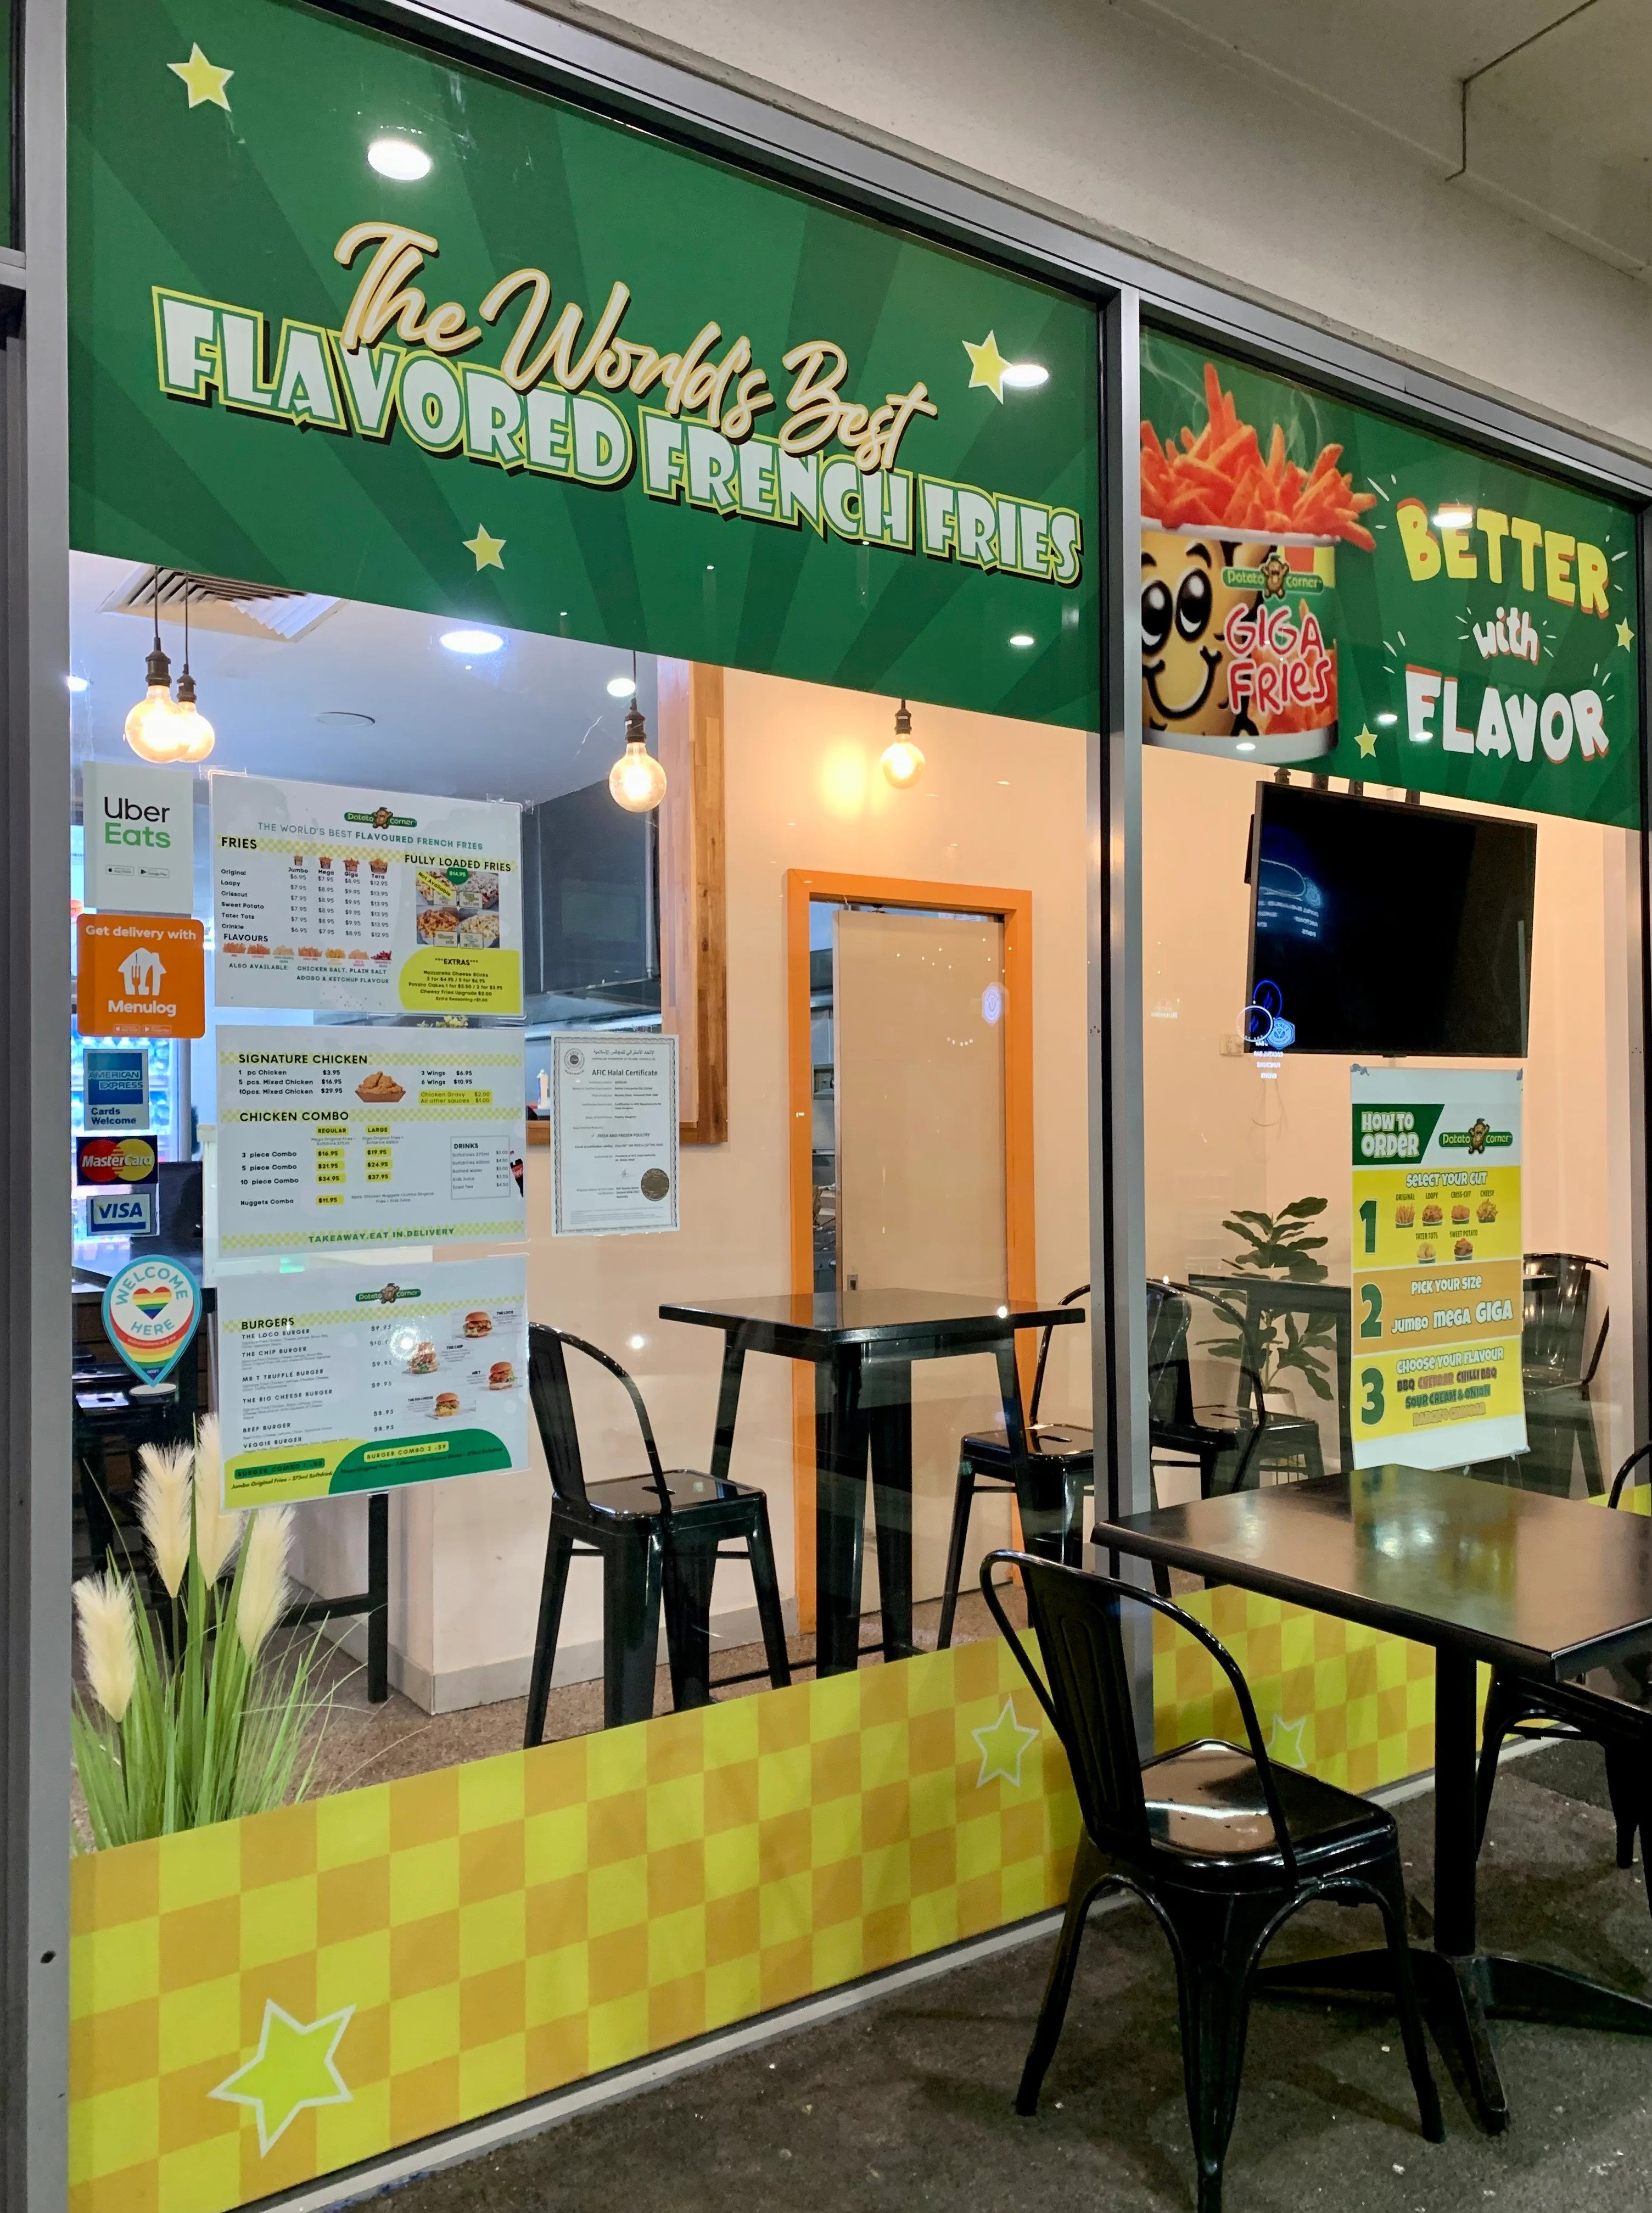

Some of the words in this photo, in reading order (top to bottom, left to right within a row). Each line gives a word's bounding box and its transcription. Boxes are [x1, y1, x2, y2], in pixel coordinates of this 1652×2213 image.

[334, 221, 481, 353] The
[479, 267, 774, 439] World's
[780, 340, 939, 472] Best
[151, 286, 636, 489] FLAVORED
[637, 404, 916, 543] FRENCH
[918, 473, 1083, 584] FRIES
[1396, 497, 1609, 619] BETTER
[1227, 569, 1264, 584] Potato
[1224, 603, 1324, 658] GIGA
[1472, 606, 1539, 665] with
[1405, 664, 1609, 764] FLAVOR
[104, 796, 170, 823] Uber
[347, 813, 374, 822] Potato
[105, 822, 171, 848] Eats
[221, 836, 257, 850] FRIES
[258, 823, 277, 831] THE
[281, 824, 325, 836] WORLD'S
[329, 829, 352, 838] BEST
[356, 832, 413, 843] FLAVOURED
[417, 837, 453, 847] FRENCH
[457, 841, 483, 850] FRIES
[405, 854, 435, 865] FULLY
[439, 858, 480, 869] LOADED
[485, 862, 511, 872] FRIES
[417, 871, 431, 882] Not
[428, 879, 452, 898] Available
[86, 925, 109, 936] Get
[113, 926, 164, 941] delivery
[167, 929, 196, 940] with
[223, 934, 268, 942] FLAVOURS
[108, 1000, 176, 1018] Menulog
[239, 1054, 308, 1064] SIGNATURE
[313, 1055, 367, 1064] CHICKEN
[91, 1117, 136, 1125] Welcome
[240, 1113, 297, 1121] CHICKEN
[302, 1111, 349, 1121] COMBO
[1361, 1111, 1395, 1133] HOW
[1396, 1111, 1414, 1132] TO
[1442, 1134, 1470, 1145] Potato
[82, 1155, 152, 1168] MasterCard
[1441, 1172, 1469, 1186] YOUR
[1469, 1171, 1488, 1186] CUT
[99, 1203, 143, 1219] VISA
[1359, 1199, 1377, 1255] 1
[115, 1266, 188, 1305] WELCOME
[1411, 1280, 1433, 1295] PICK
[1434, 1277, 1460, 1293] YOUR
[1360, 1283, 1382, 1339] 2
[1475, 1299, 1514, 1323] GIGA
[131, 1319, 175, 1335] HERE
[242, 1317, 294, 1330] BURGERS
[1437, 1352, 1463, 1369] YOUR
[1464, 1346, 1504, 1365] FLAVOUR
[1397, 1378, 1415, 1392] BBQ
[1456, 1368, 1480, 1383] CHILLI
[1481, 1366, 1497, 1380] BBQ
[1360, 1366, 1385, 1426] 3
[1405, 1394, 1429, 1410] SOUR
[1430, 1389, 1457, 1406] CREAM
[1464, 1384, 1491, 1399] ONION
[275, 1437, 302, 1445] BURGER
[367, 1451, 394, 1460] BURGER
[398, 1447, 424, 1455] COMBO
